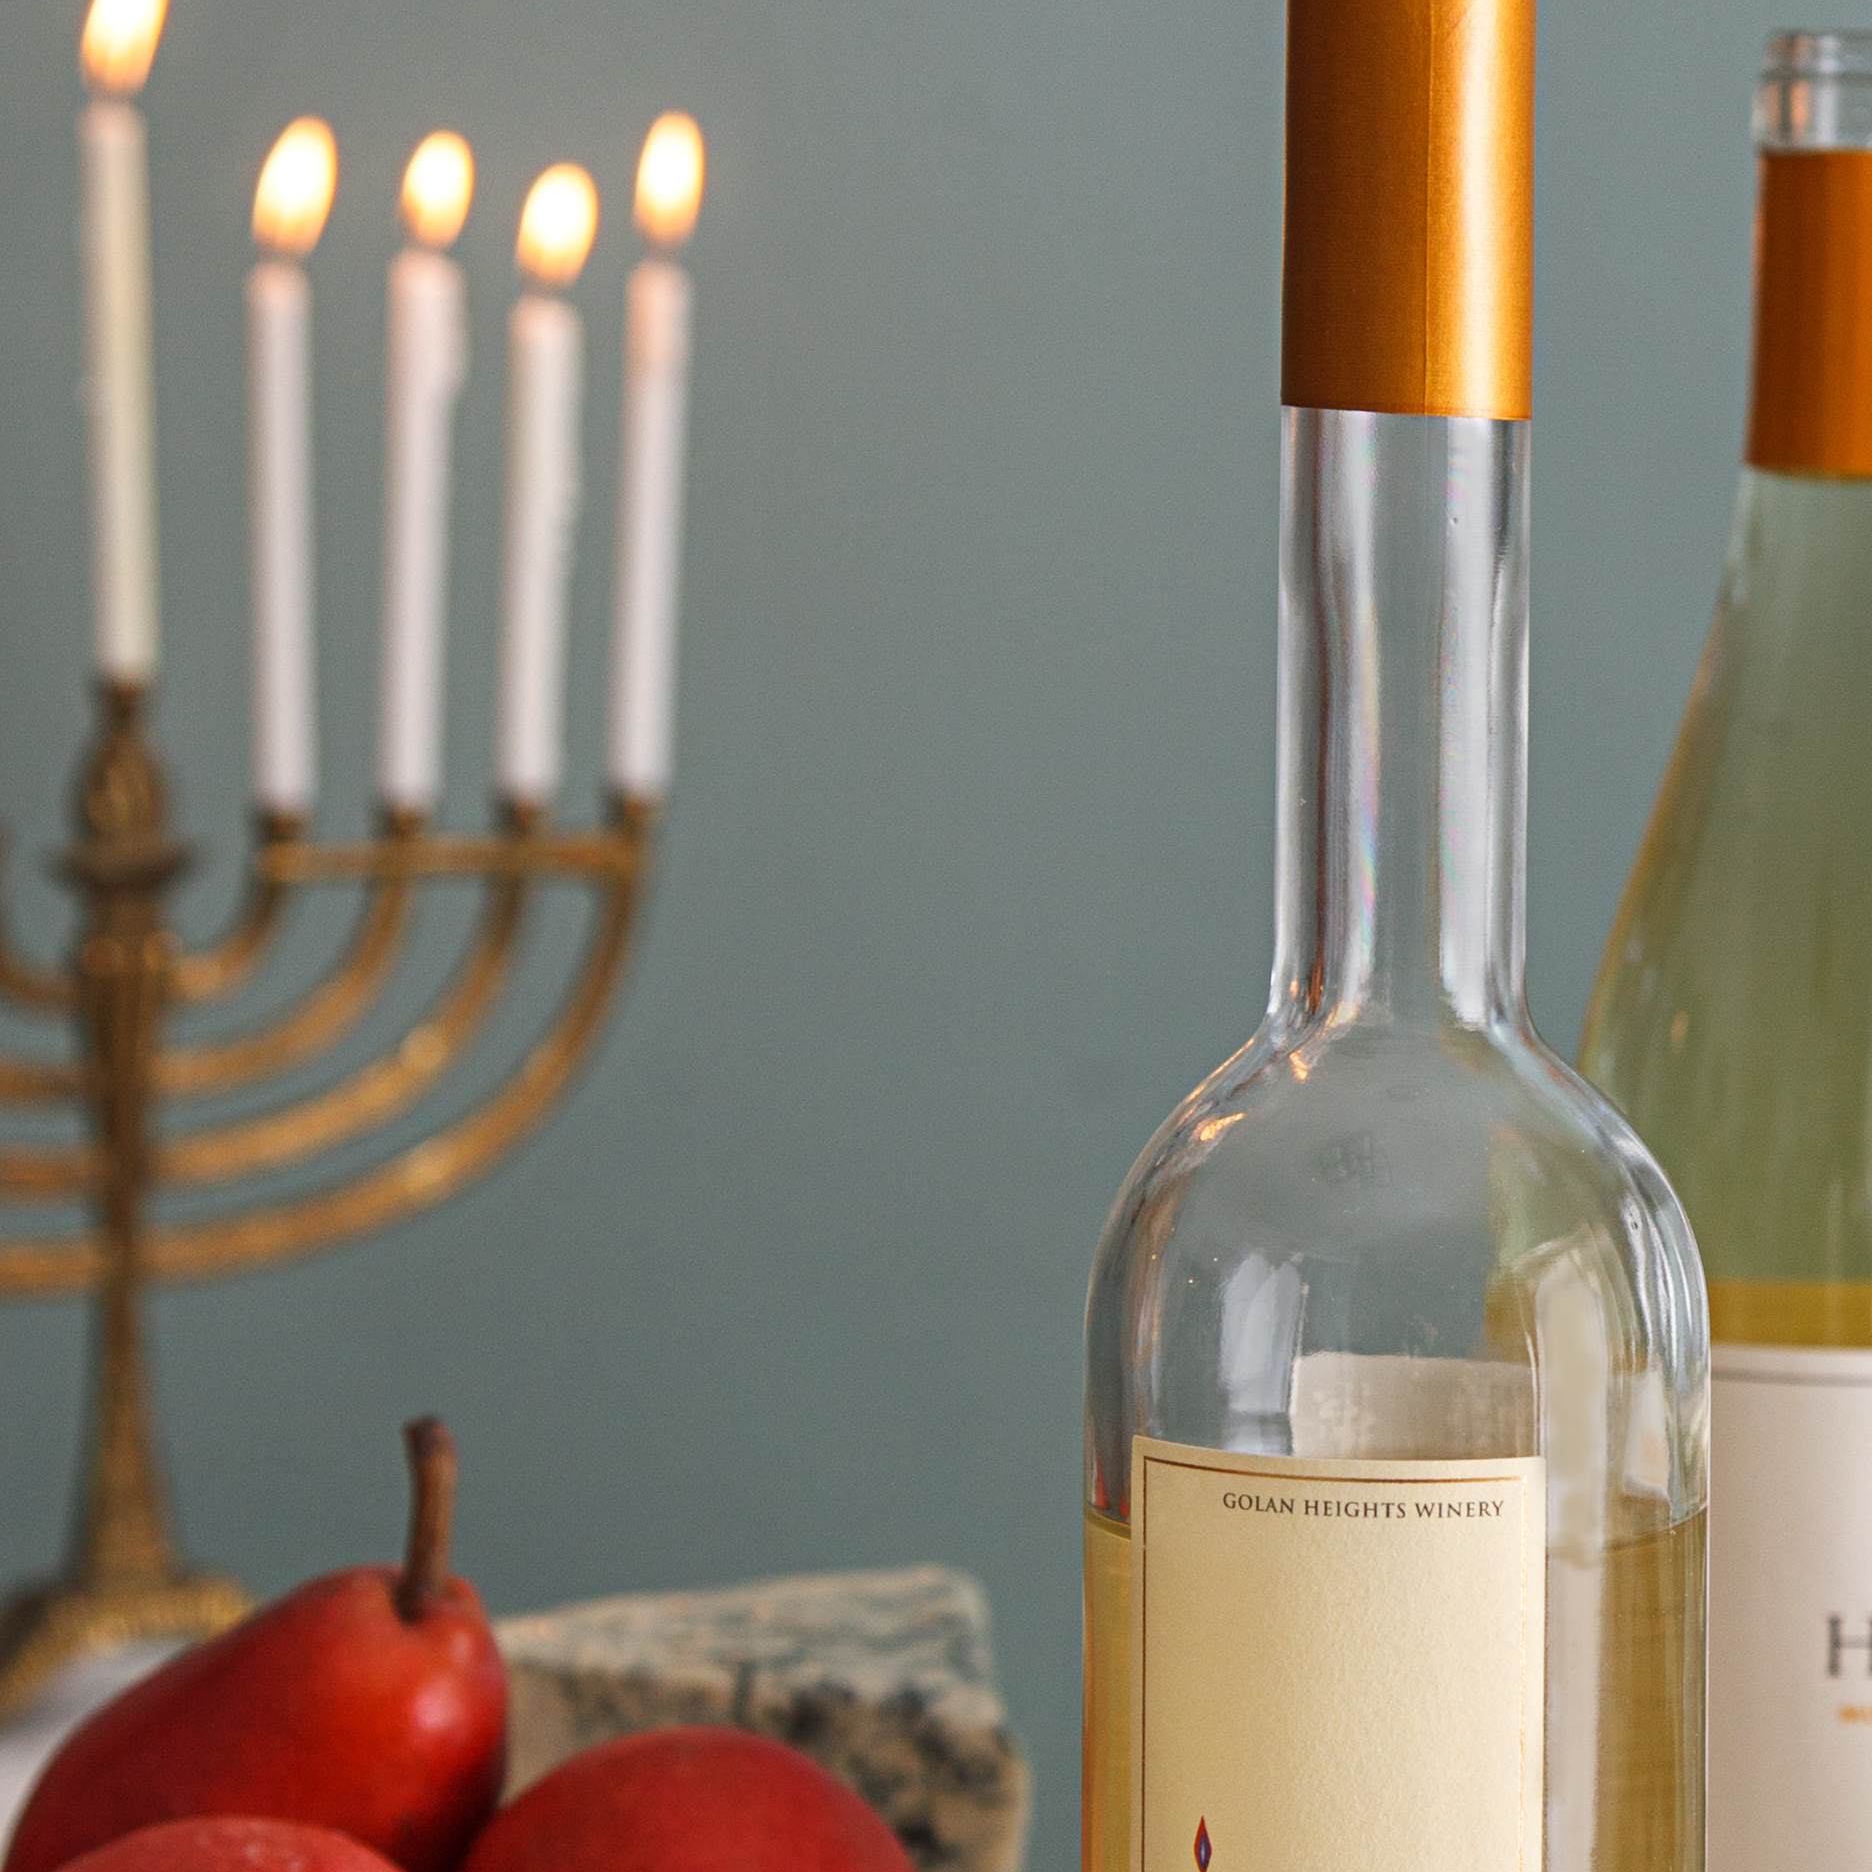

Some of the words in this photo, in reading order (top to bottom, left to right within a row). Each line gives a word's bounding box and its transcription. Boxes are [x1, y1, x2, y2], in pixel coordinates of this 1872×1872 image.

[1222, 1492, 1295, 1515] GOLAN
[1303, 1499, 1407, 1519] HEIGHTS
[1414, 1500, 1505, 1519] WINERY
